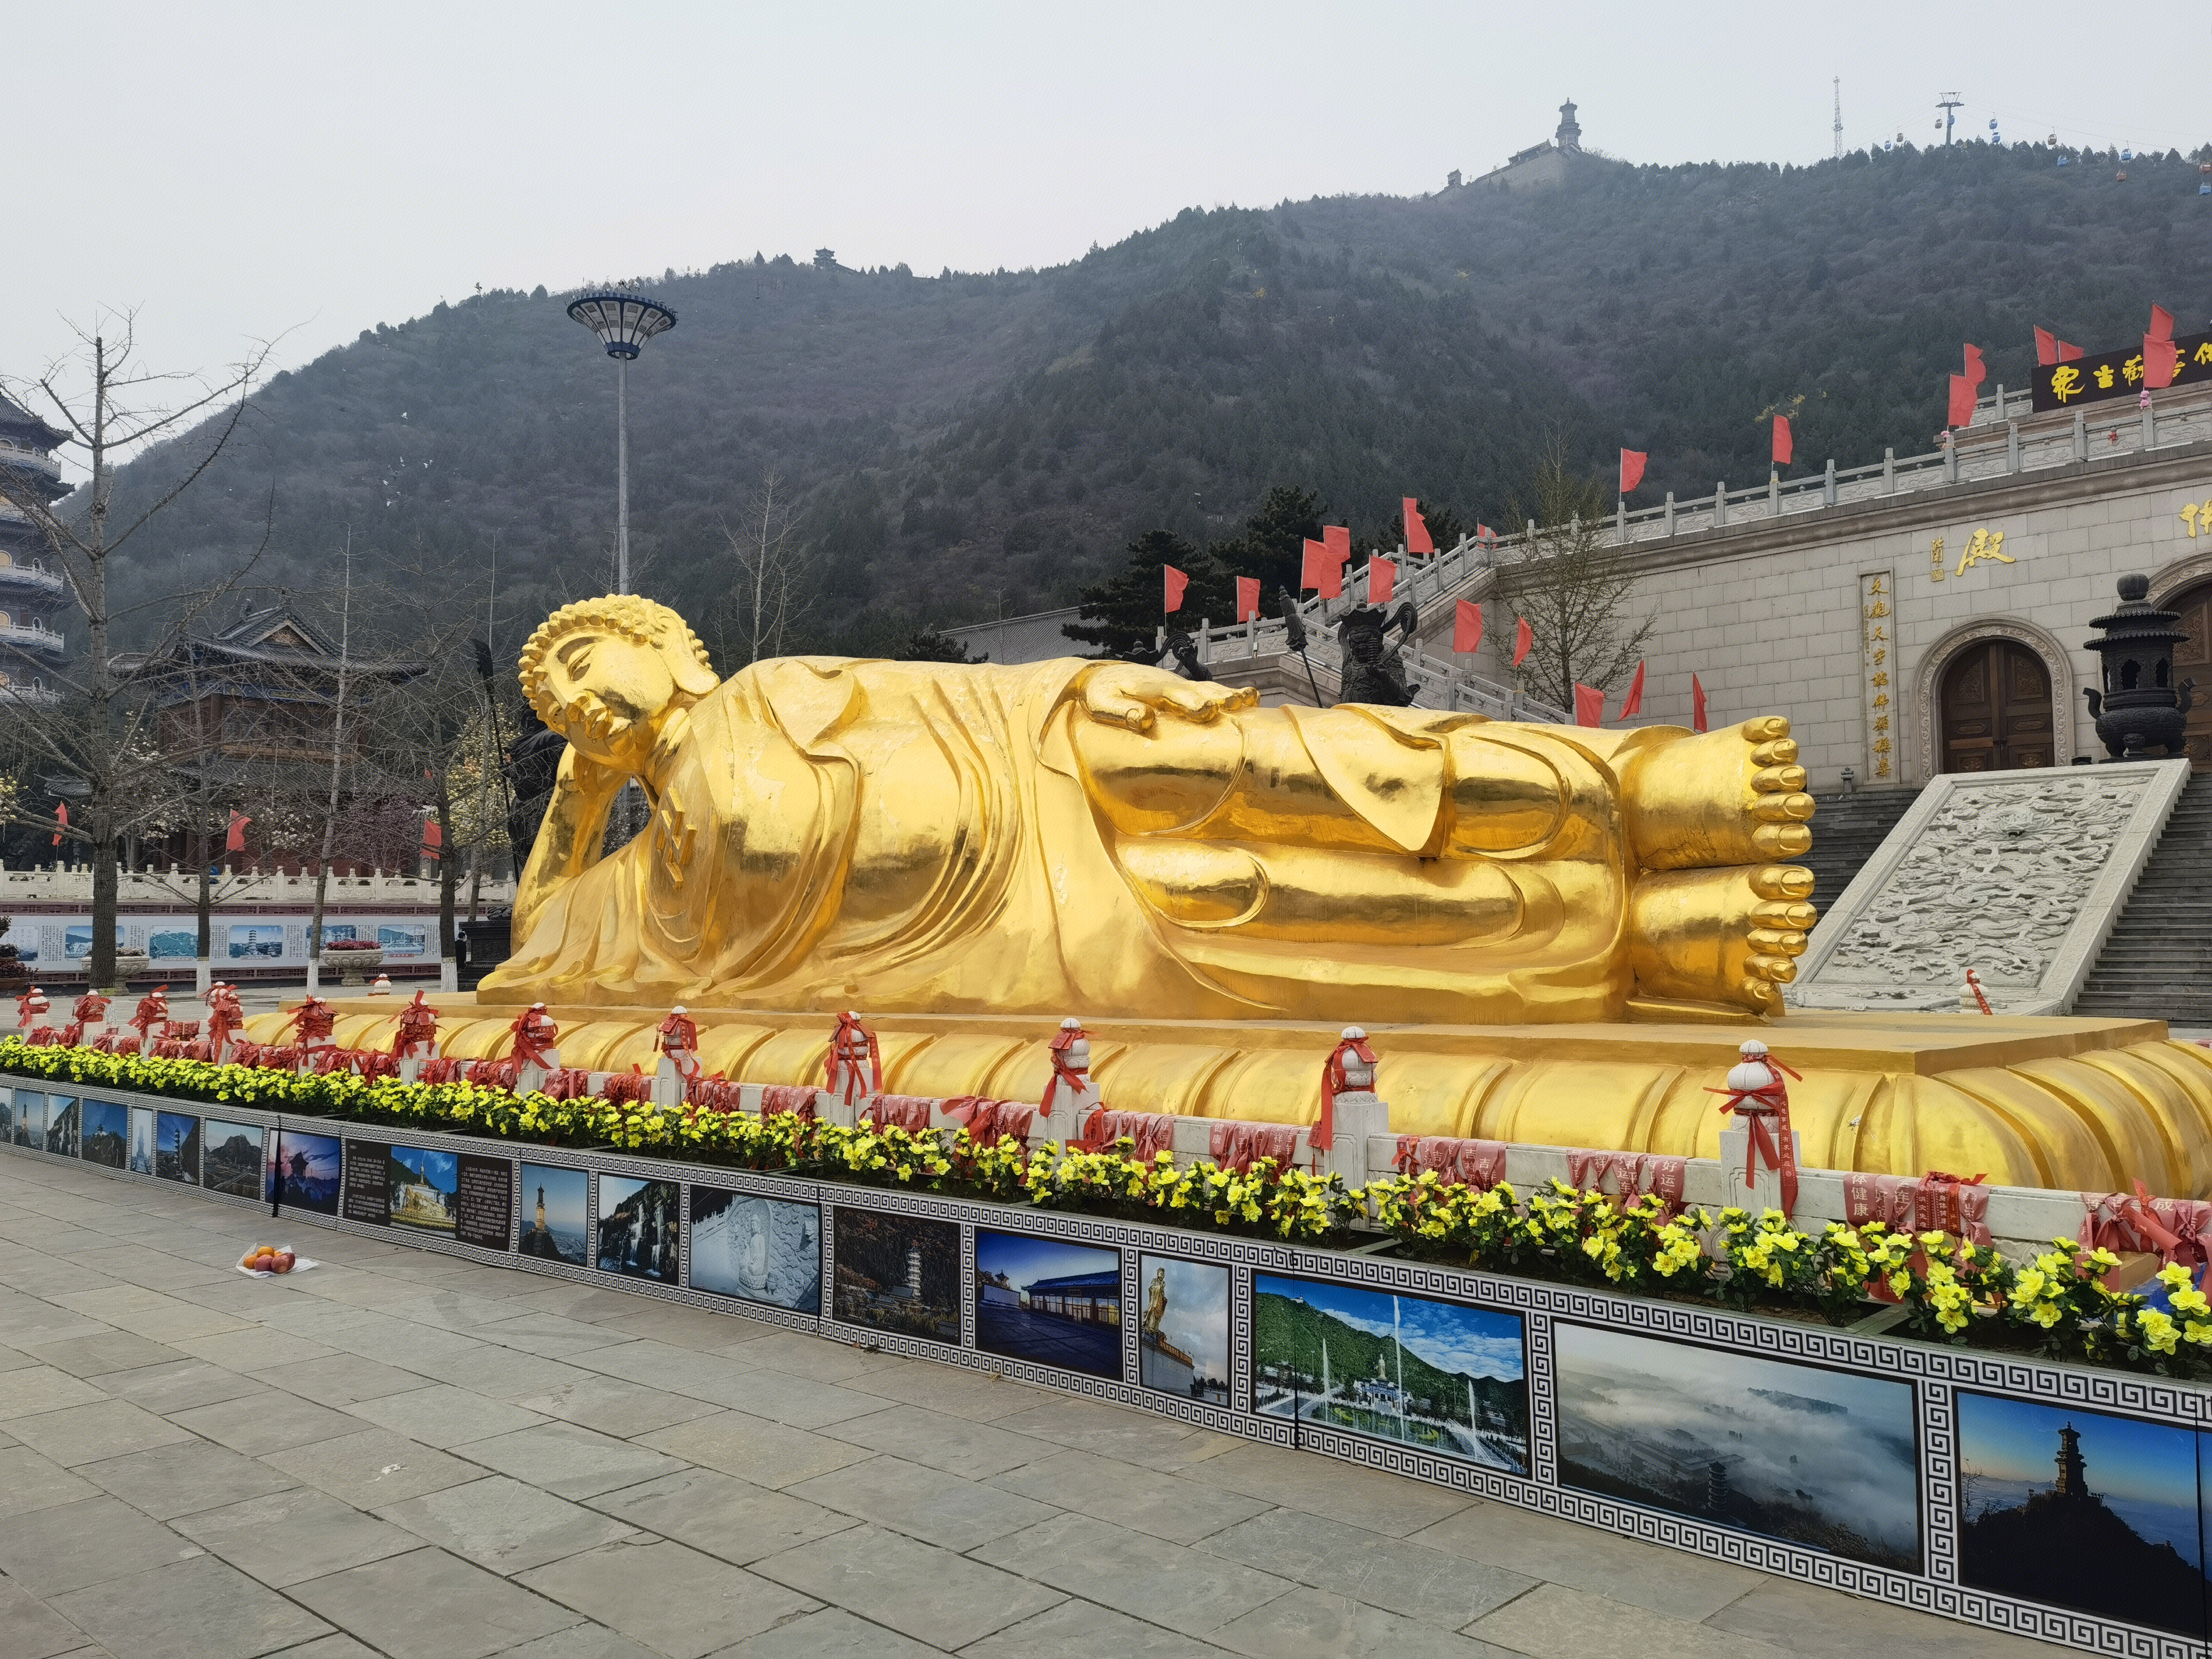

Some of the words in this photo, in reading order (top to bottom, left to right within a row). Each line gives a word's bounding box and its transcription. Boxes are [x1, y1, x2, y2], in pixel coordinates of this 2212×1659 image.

[1212, 1123, 1224, 1144] 健康
[1851, 1174, 1869, 1216] 体健康
